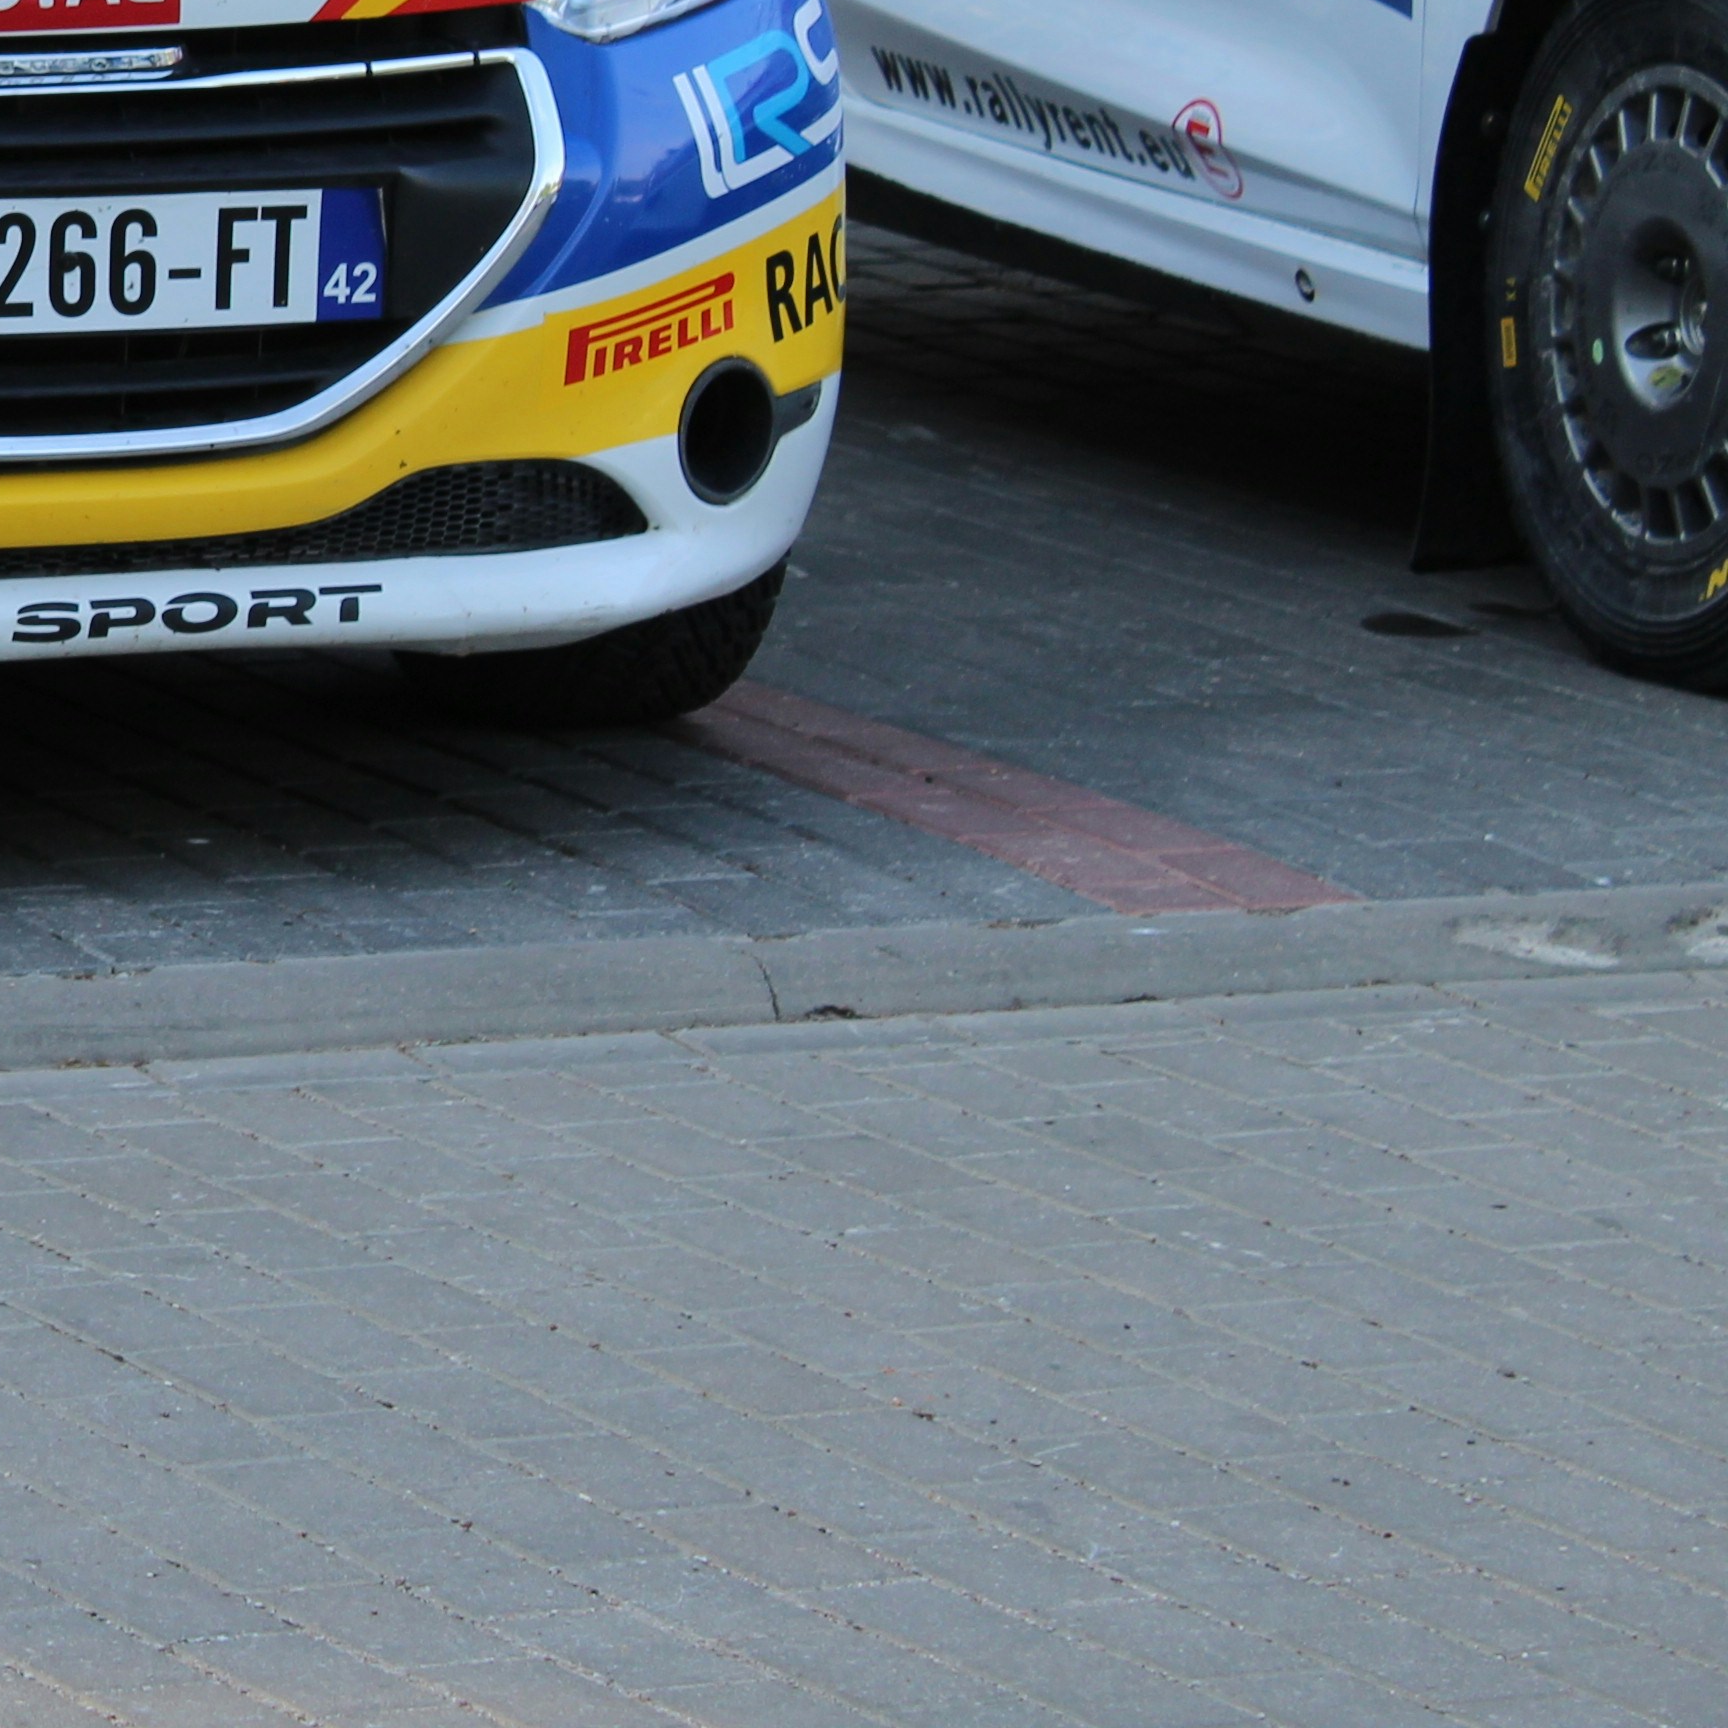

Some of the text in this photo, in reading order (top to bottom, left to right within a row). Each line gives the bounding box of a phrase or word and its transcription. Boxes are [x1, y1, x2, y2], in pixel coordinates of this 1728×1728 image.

[870, 45, 1196, 181] www.rallyrent.eu
[323, 262, 379, 304] 42
[563, 272, 736, 386] PIRELLI
[11, 583, 384, 643] SPORT
